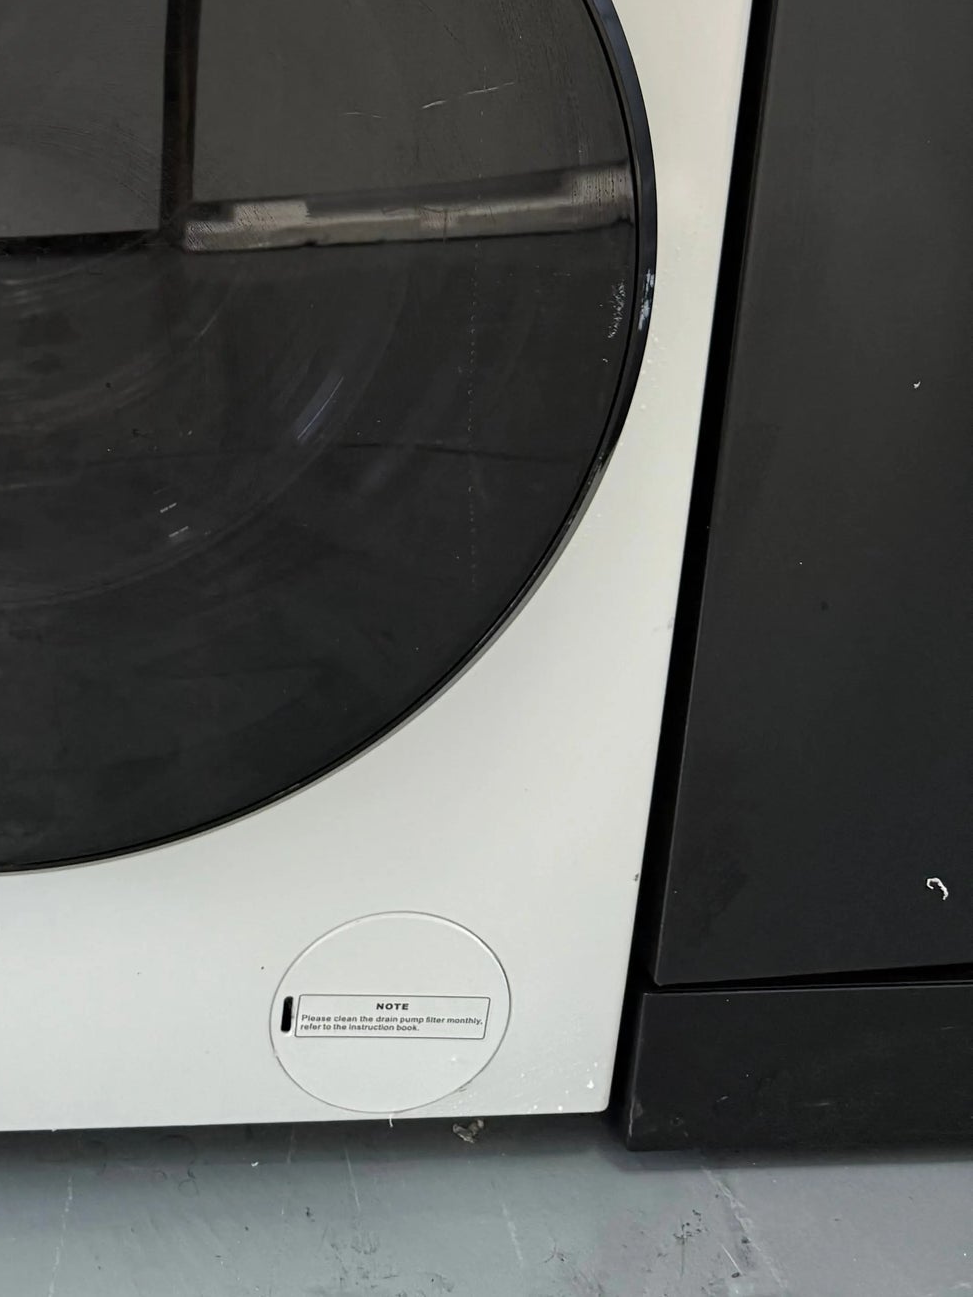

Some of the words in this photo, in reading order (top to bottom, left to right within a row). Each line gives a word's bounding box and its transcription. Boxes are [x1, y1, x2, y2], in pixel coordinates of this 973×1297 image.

[376, 1002, 409, 1011] NOTE
[301, 1014, 331, 1023] Please
[334, 1015, 357, 1023] clean
[359, 1015, 373, 1023] the
[375, 1015, 398, 1023] drain
[400, 1016, 424, 1025] pump
[426, 1016, 445, 1024] filter
[446, 1017, 483, 1026] monthly,
[300, 1023, 321, 1031] refer
[323, 1023, 331, 1031] to
[333, 1023, 346, 1031] the
[348, 1023, 394, 1032] instruction
[396, 1024, 420, 1032] book.
